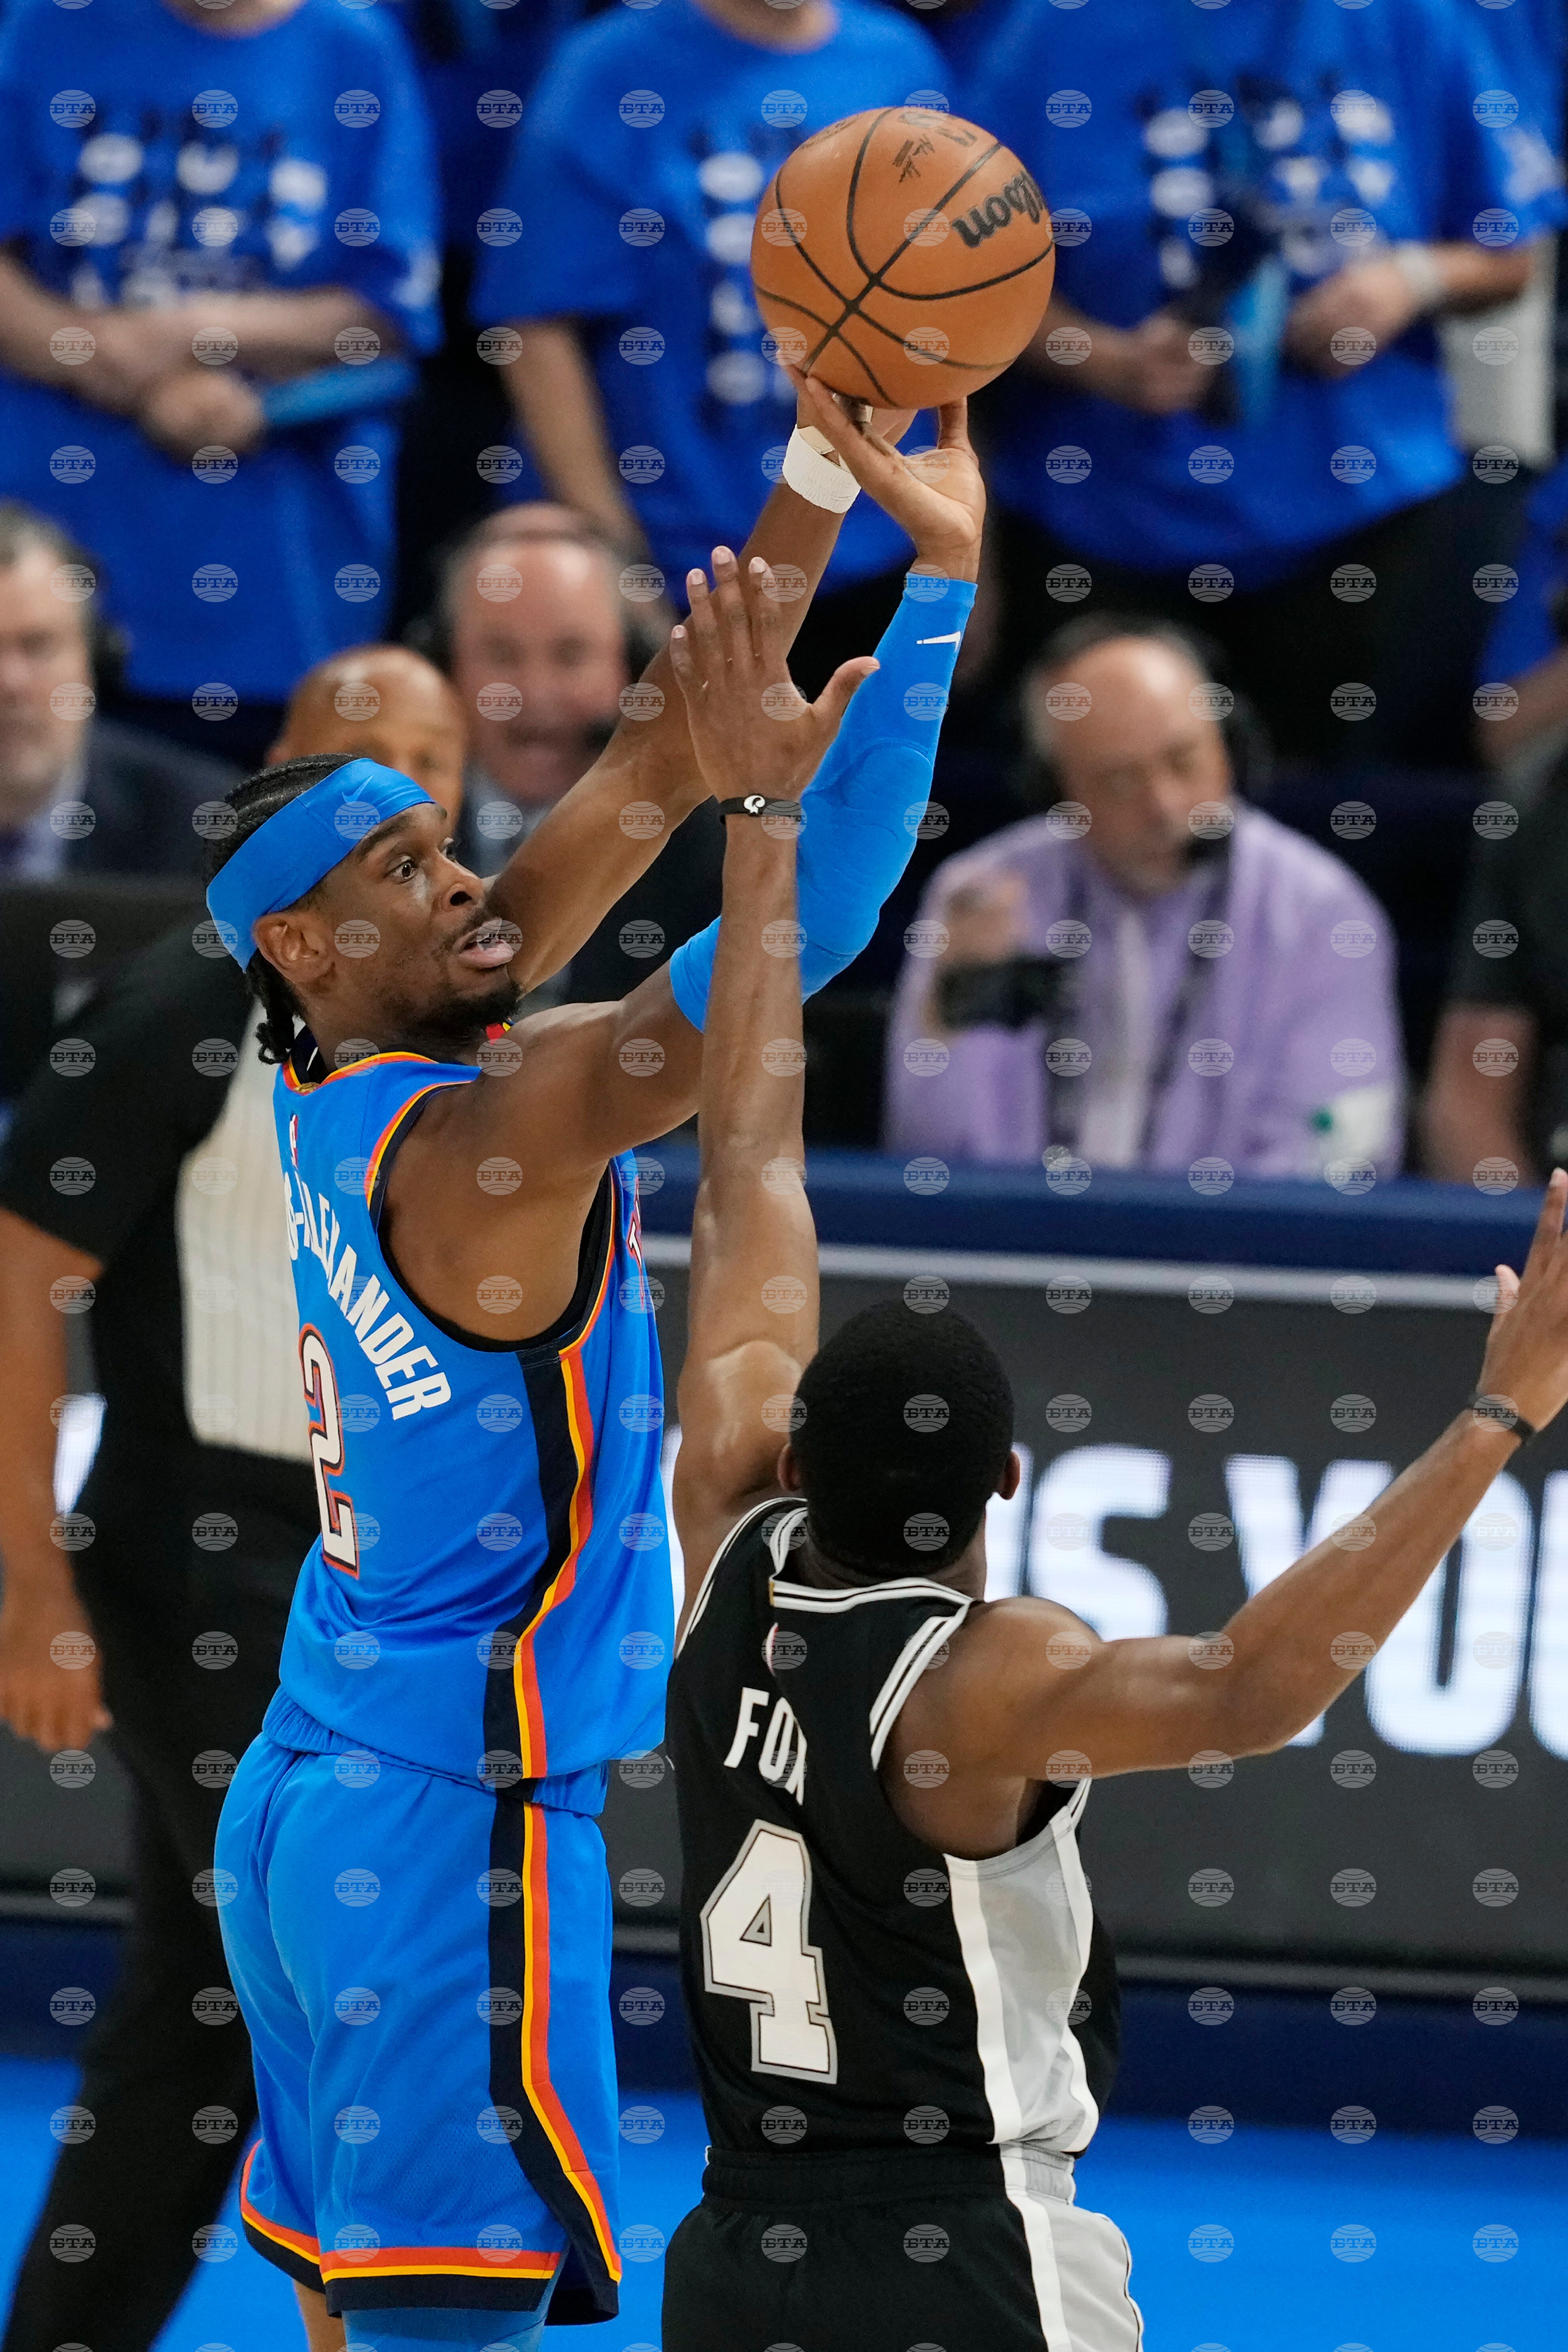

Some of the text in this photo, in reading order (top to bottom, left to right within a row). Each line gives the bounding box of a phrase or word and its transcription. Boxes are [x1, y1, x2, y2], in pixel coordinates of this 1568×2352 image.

[299, 1323, 360, 1580] 2
[723, 1686, 808, 1806] FOX
[699, 1819, 838, 2085] 4
